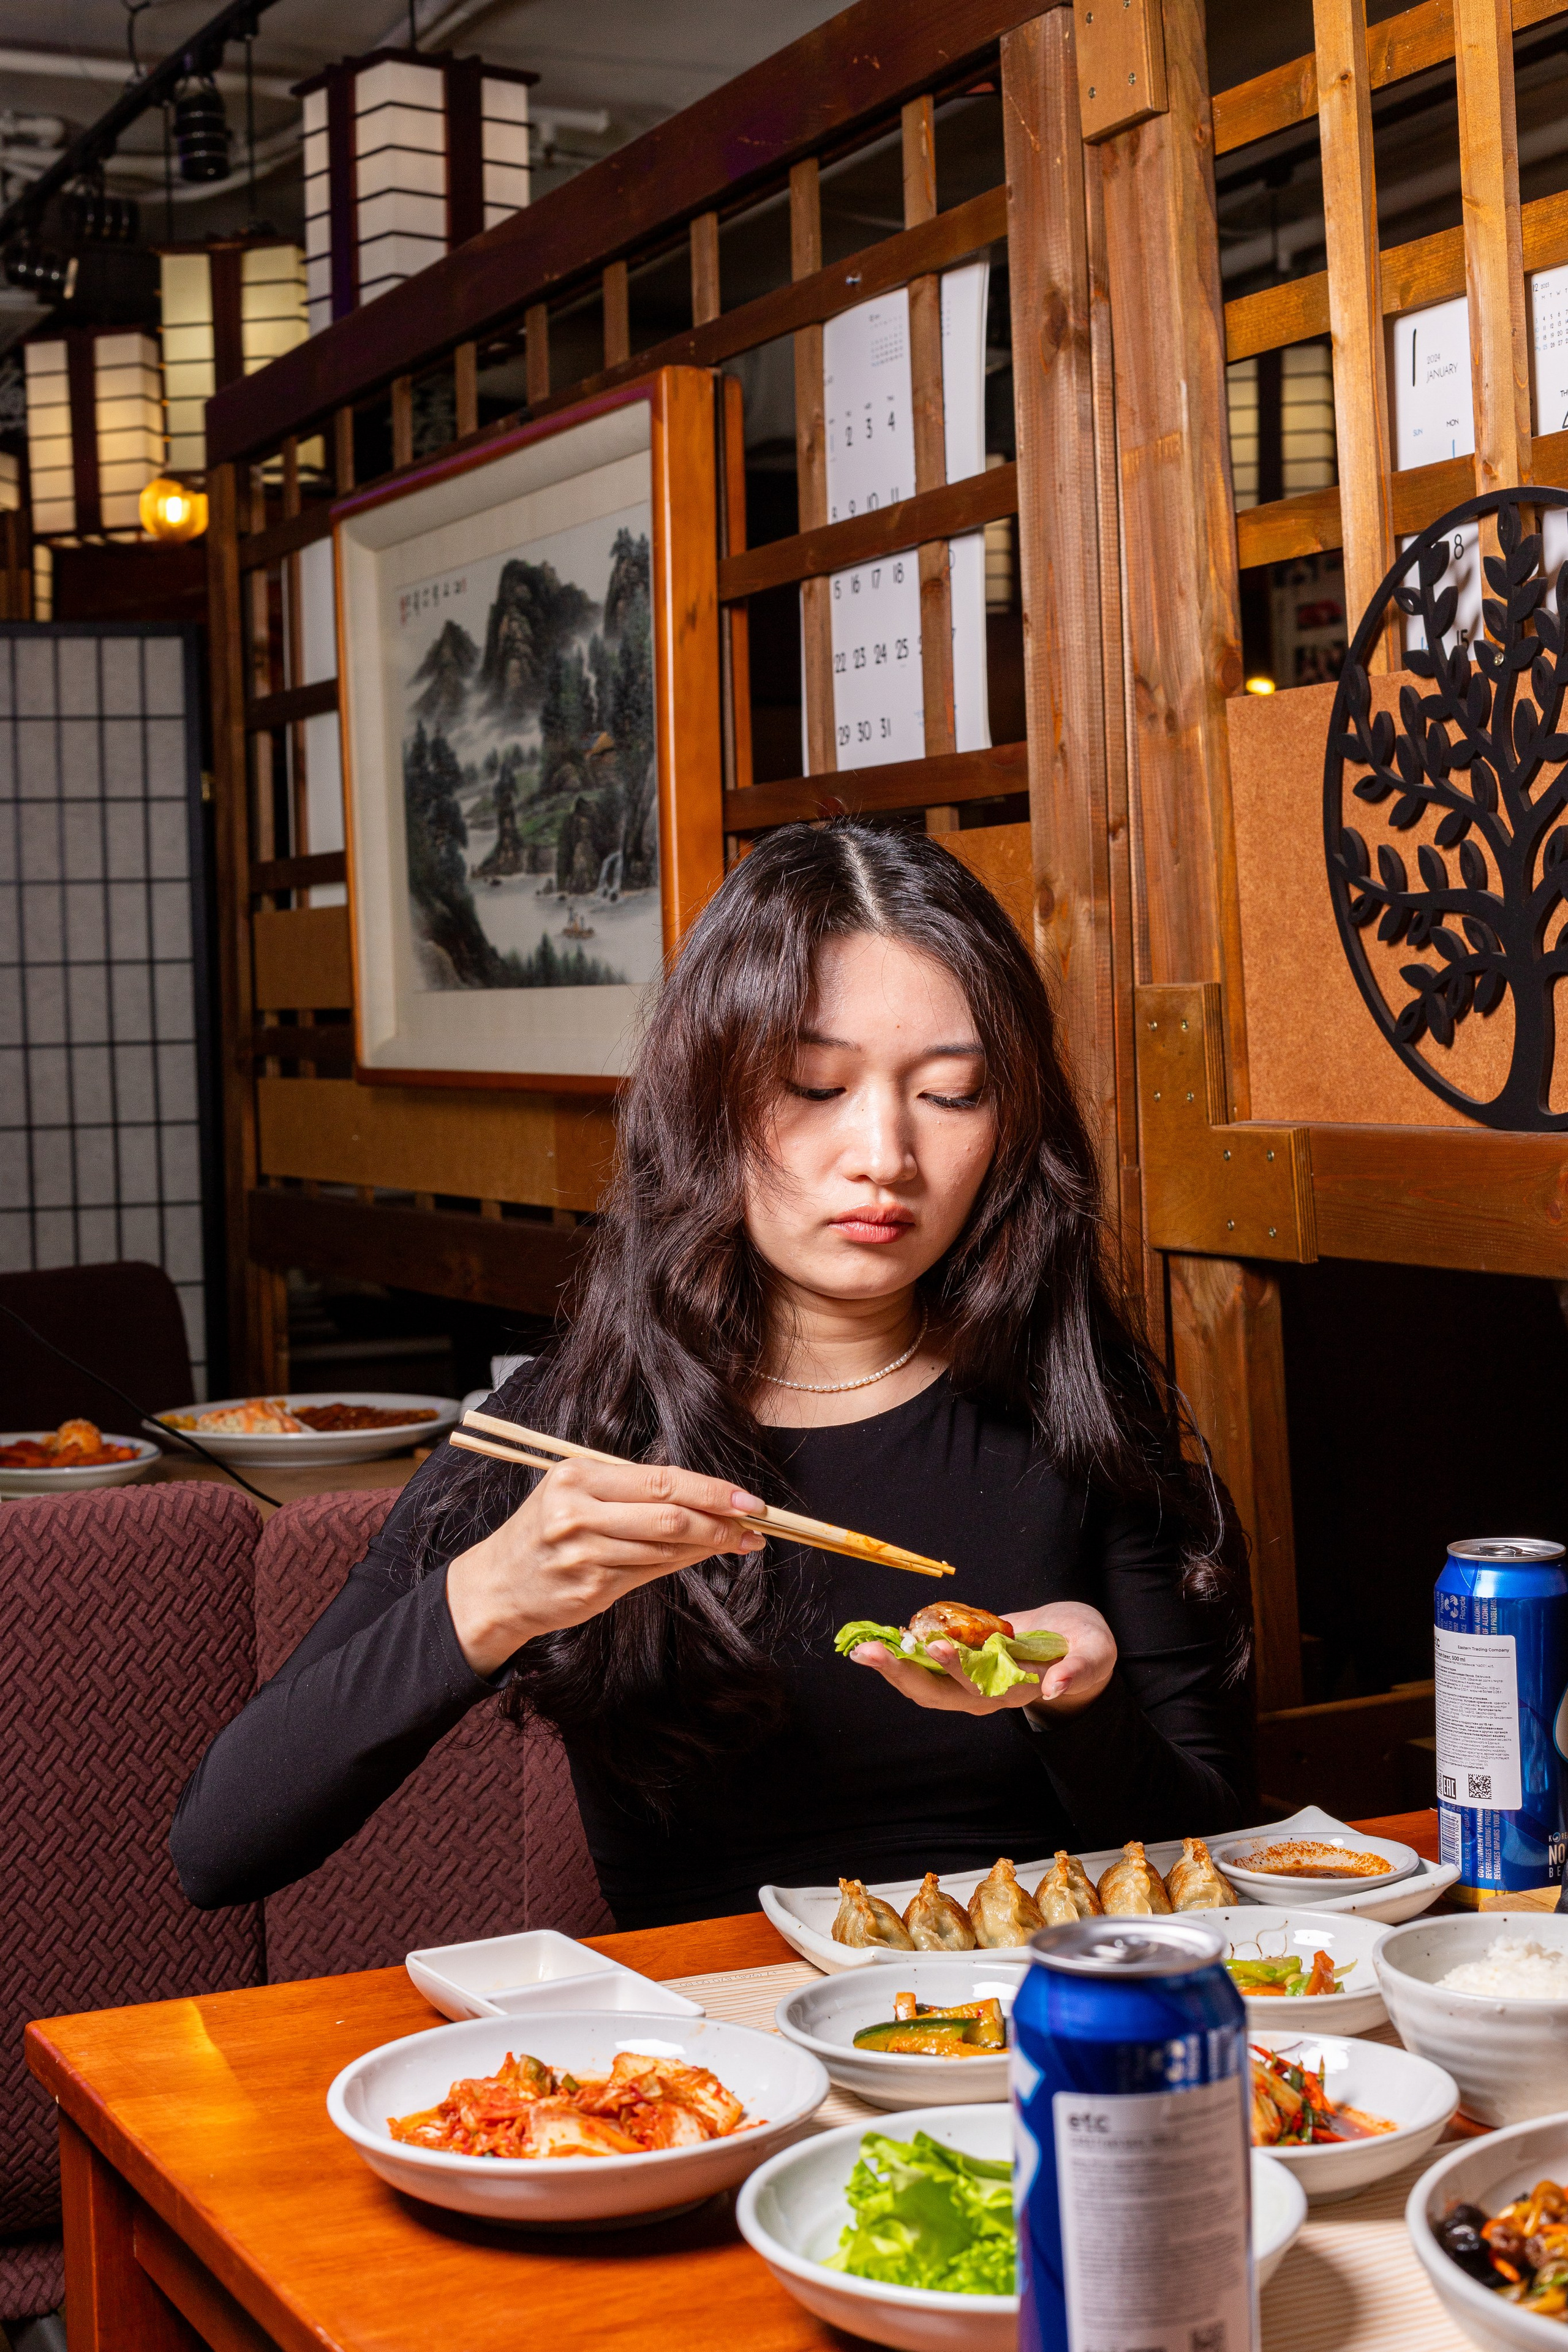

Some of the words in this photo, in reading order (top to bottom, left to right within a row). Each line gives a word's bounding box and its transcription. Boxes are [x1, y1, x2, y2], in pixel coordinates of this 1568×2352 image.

[1427, 353, 1441, 364] 2024
[1427, 363, 1458, 383] JANUARY
[846, 426, 853, 447] 2
[865, 417, 873, 439] 3
[888, 411, 895, 431] 4
[1446, 418, 1459, 427] MON
[867, 492, 880, 512] 10
[1454, 534, 1464, 560] 8
[850, 574, 861, 594] 16
[871, 569, 881, 589] 17
[893, 563, 904, 583] 18
[835, 653, 846, 673] 22
[853, 647, 867, 669] 23
[874, 643, 887, 665] 24
[895, 638, 909, 660] 25
[838, 725, 850, 745] 29
[858, 720, 872, 742] 30
[880, 718, 891, 737] 31
